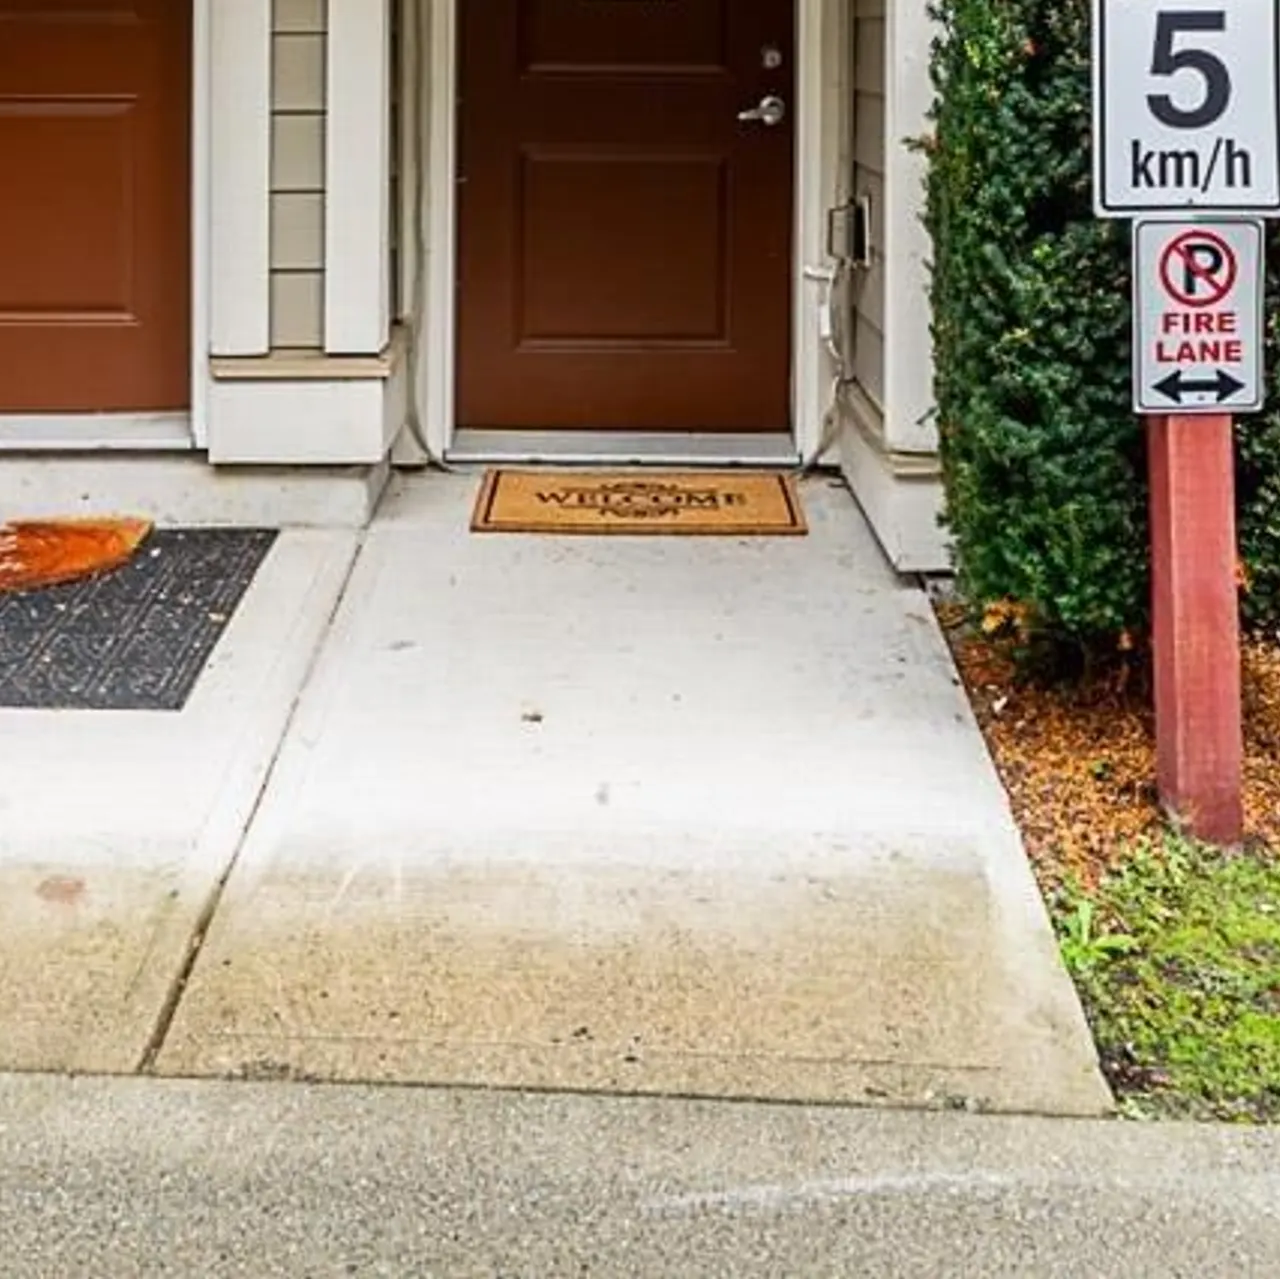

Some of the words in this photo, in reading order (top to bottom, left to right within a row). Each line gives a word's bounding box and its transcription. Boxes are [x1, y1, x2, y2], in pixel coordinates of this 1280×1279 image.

[1146, 10, 1232, 129] 5
[1131, 138, 1251, 192] km/h
[1162, 312, 1236, 334] FIRE
[1156, 341, 1242, 363] LANE
[536, 492, 746, 507] WELCOME
